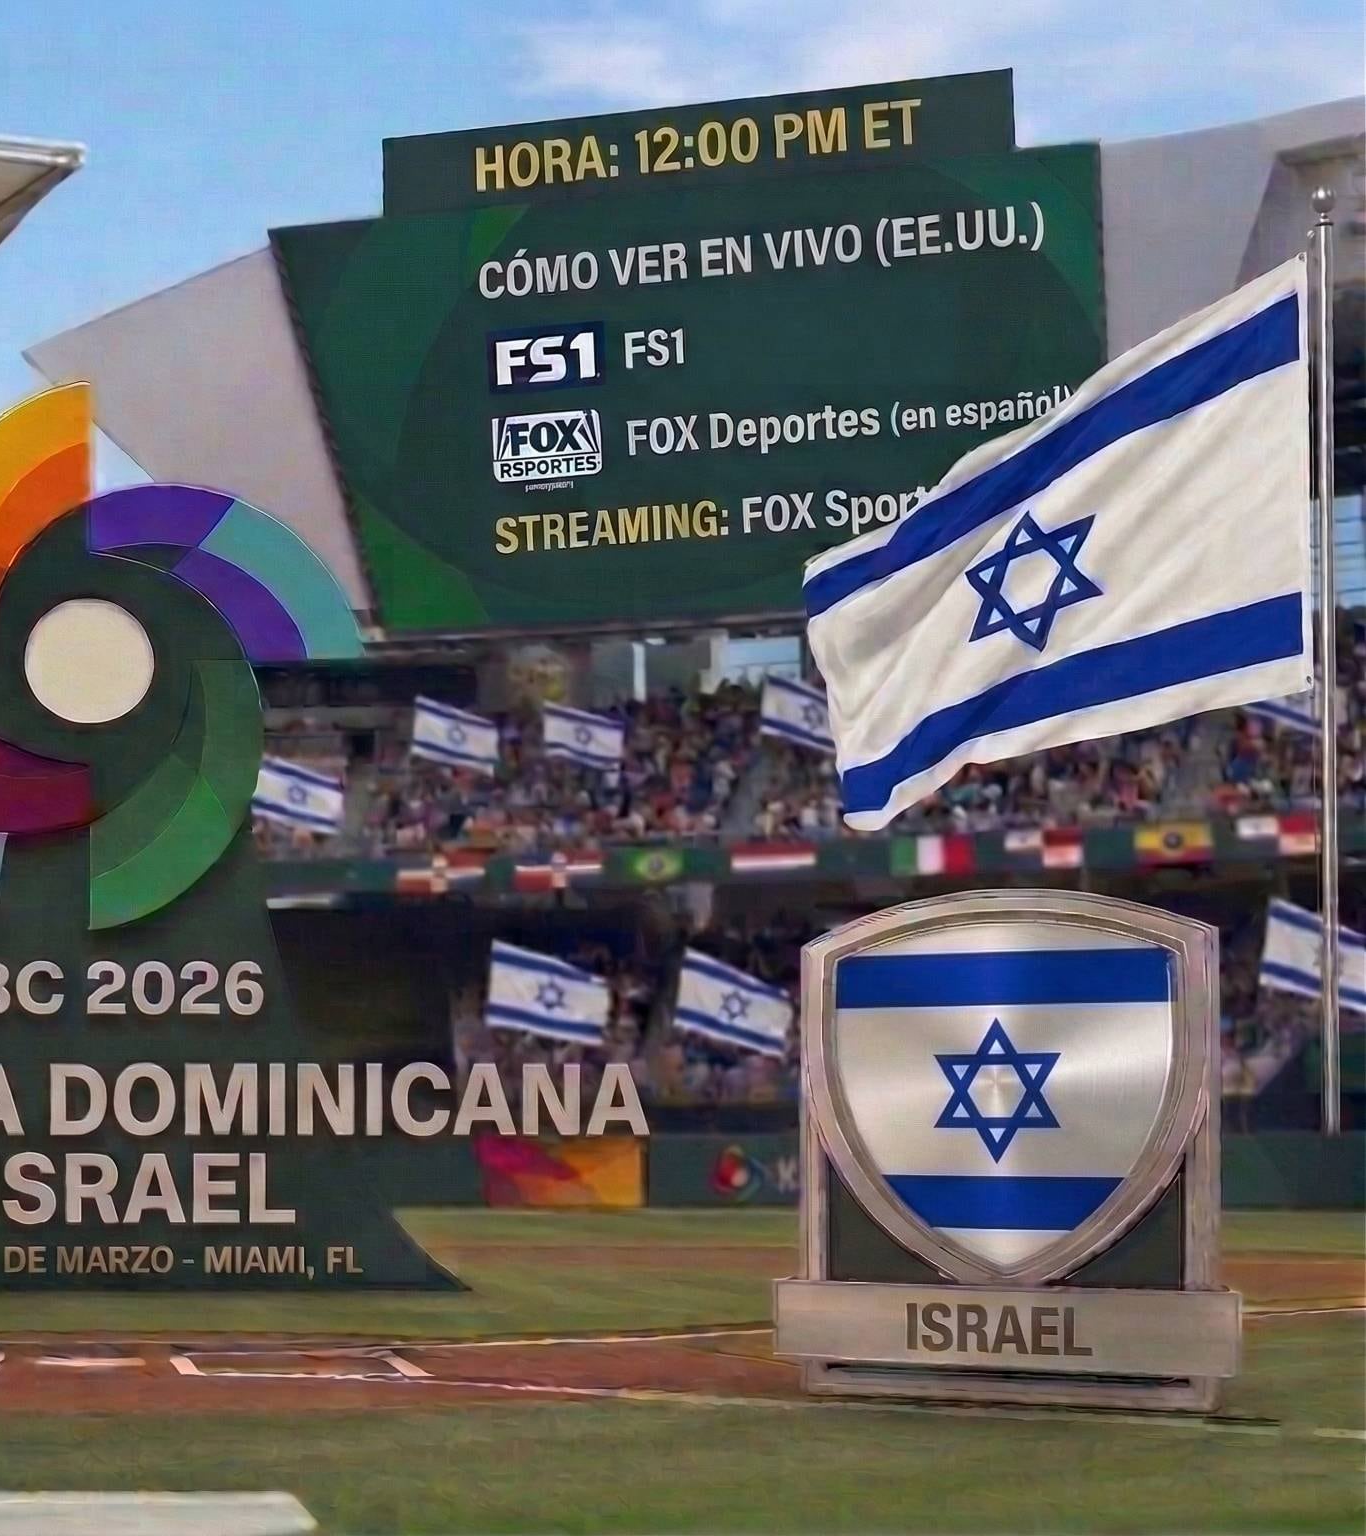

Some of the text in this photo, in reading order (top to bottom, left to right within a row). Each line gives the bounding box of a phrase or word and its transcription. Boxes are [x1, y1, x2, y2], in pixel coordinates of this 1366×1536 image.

[474, 98, 922, 192] HORA: 12:00 PM ET
[478, 201, 1045, 299] CÓMO VER EN VIVO (EE.UU.)
[495, 332, 597, 386] FS1
[624, 328, 684, 369] FS1
[507, 418, 584, 456] FOX
[626, 414, 700, 456] FOX
[709, 405, 880, 454] Deportes
[890, 401, 936, 437] (en
[495, 500, 729, 554] STREAMING:
[742, 492, 816, 534] FOX
[86, 960, 265, 1015] 2026
[49, 1062, 651, 1137] DOMINICANA
[4, 1246, 46, 1275] DE
[56, 1246, 175, 1275] MARZO
[204, 1246, 316, 1281] MIAMI,
[327, 1246, 364, 1275] FL
[905, 1302, 1093, 1356] ISRAEL
